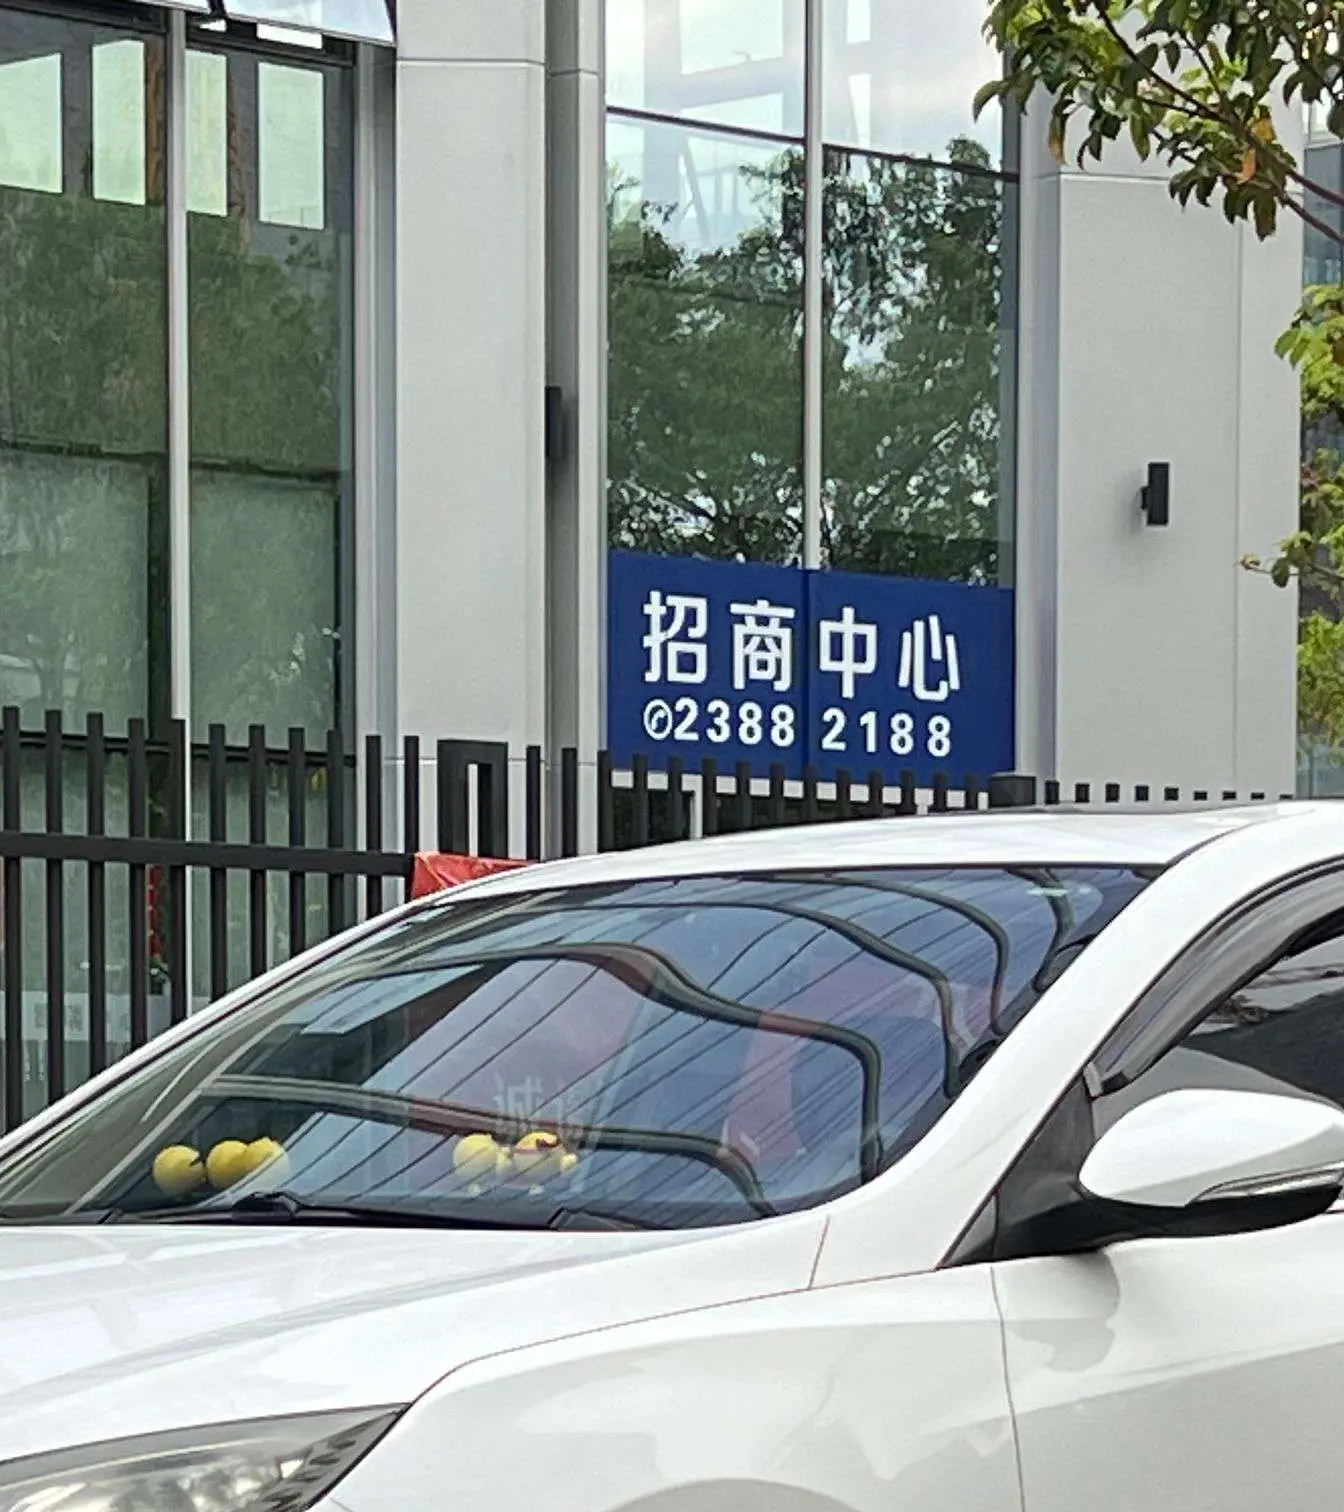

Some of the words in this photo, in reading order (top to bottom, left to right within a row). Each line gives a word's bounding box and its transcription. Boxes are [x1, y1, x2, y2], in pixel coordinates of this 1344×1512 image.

[643, 590, 961, 701] 招商中心
[821, 707, 951, 757] 2188
